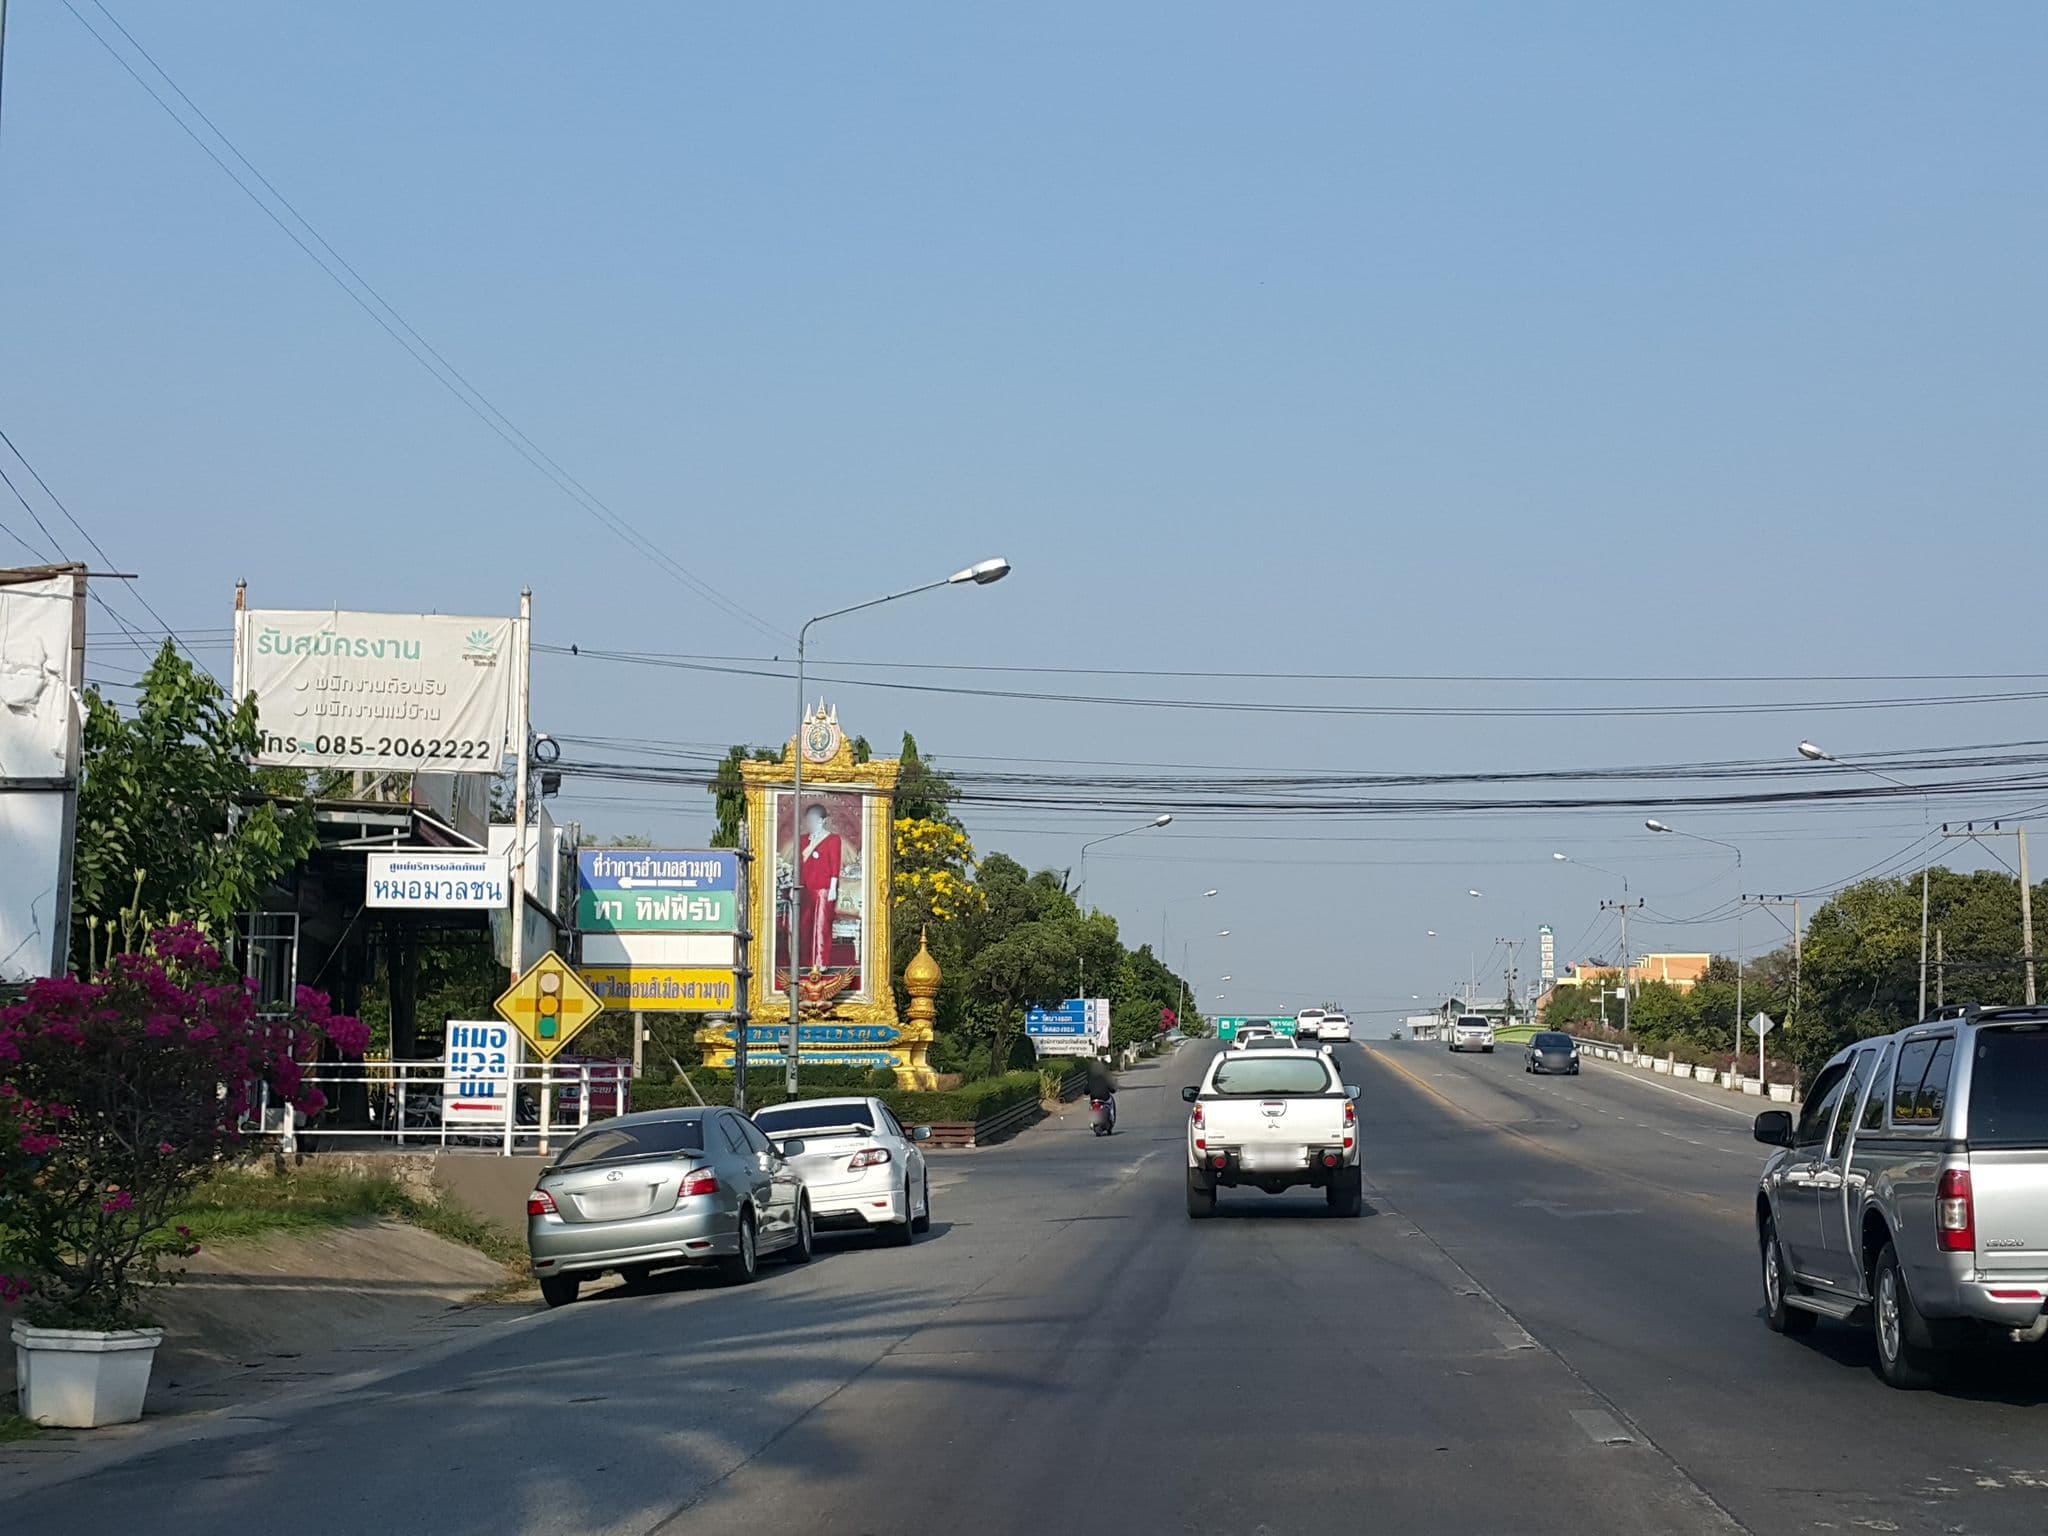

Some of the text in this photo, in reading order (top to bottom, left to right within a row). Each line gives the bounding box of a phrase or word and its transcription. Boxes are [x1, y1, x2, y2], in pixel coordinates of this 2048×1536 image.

[257, 627, 421, 660] รับสมัครงาน
[315, 734, 490, 760] 085-2062222
[373, 880, 503, 901] หมอมวลชน
[452, 1027, 507, 1049] หมอ
[451, 1052, 506, 1073] มวล
